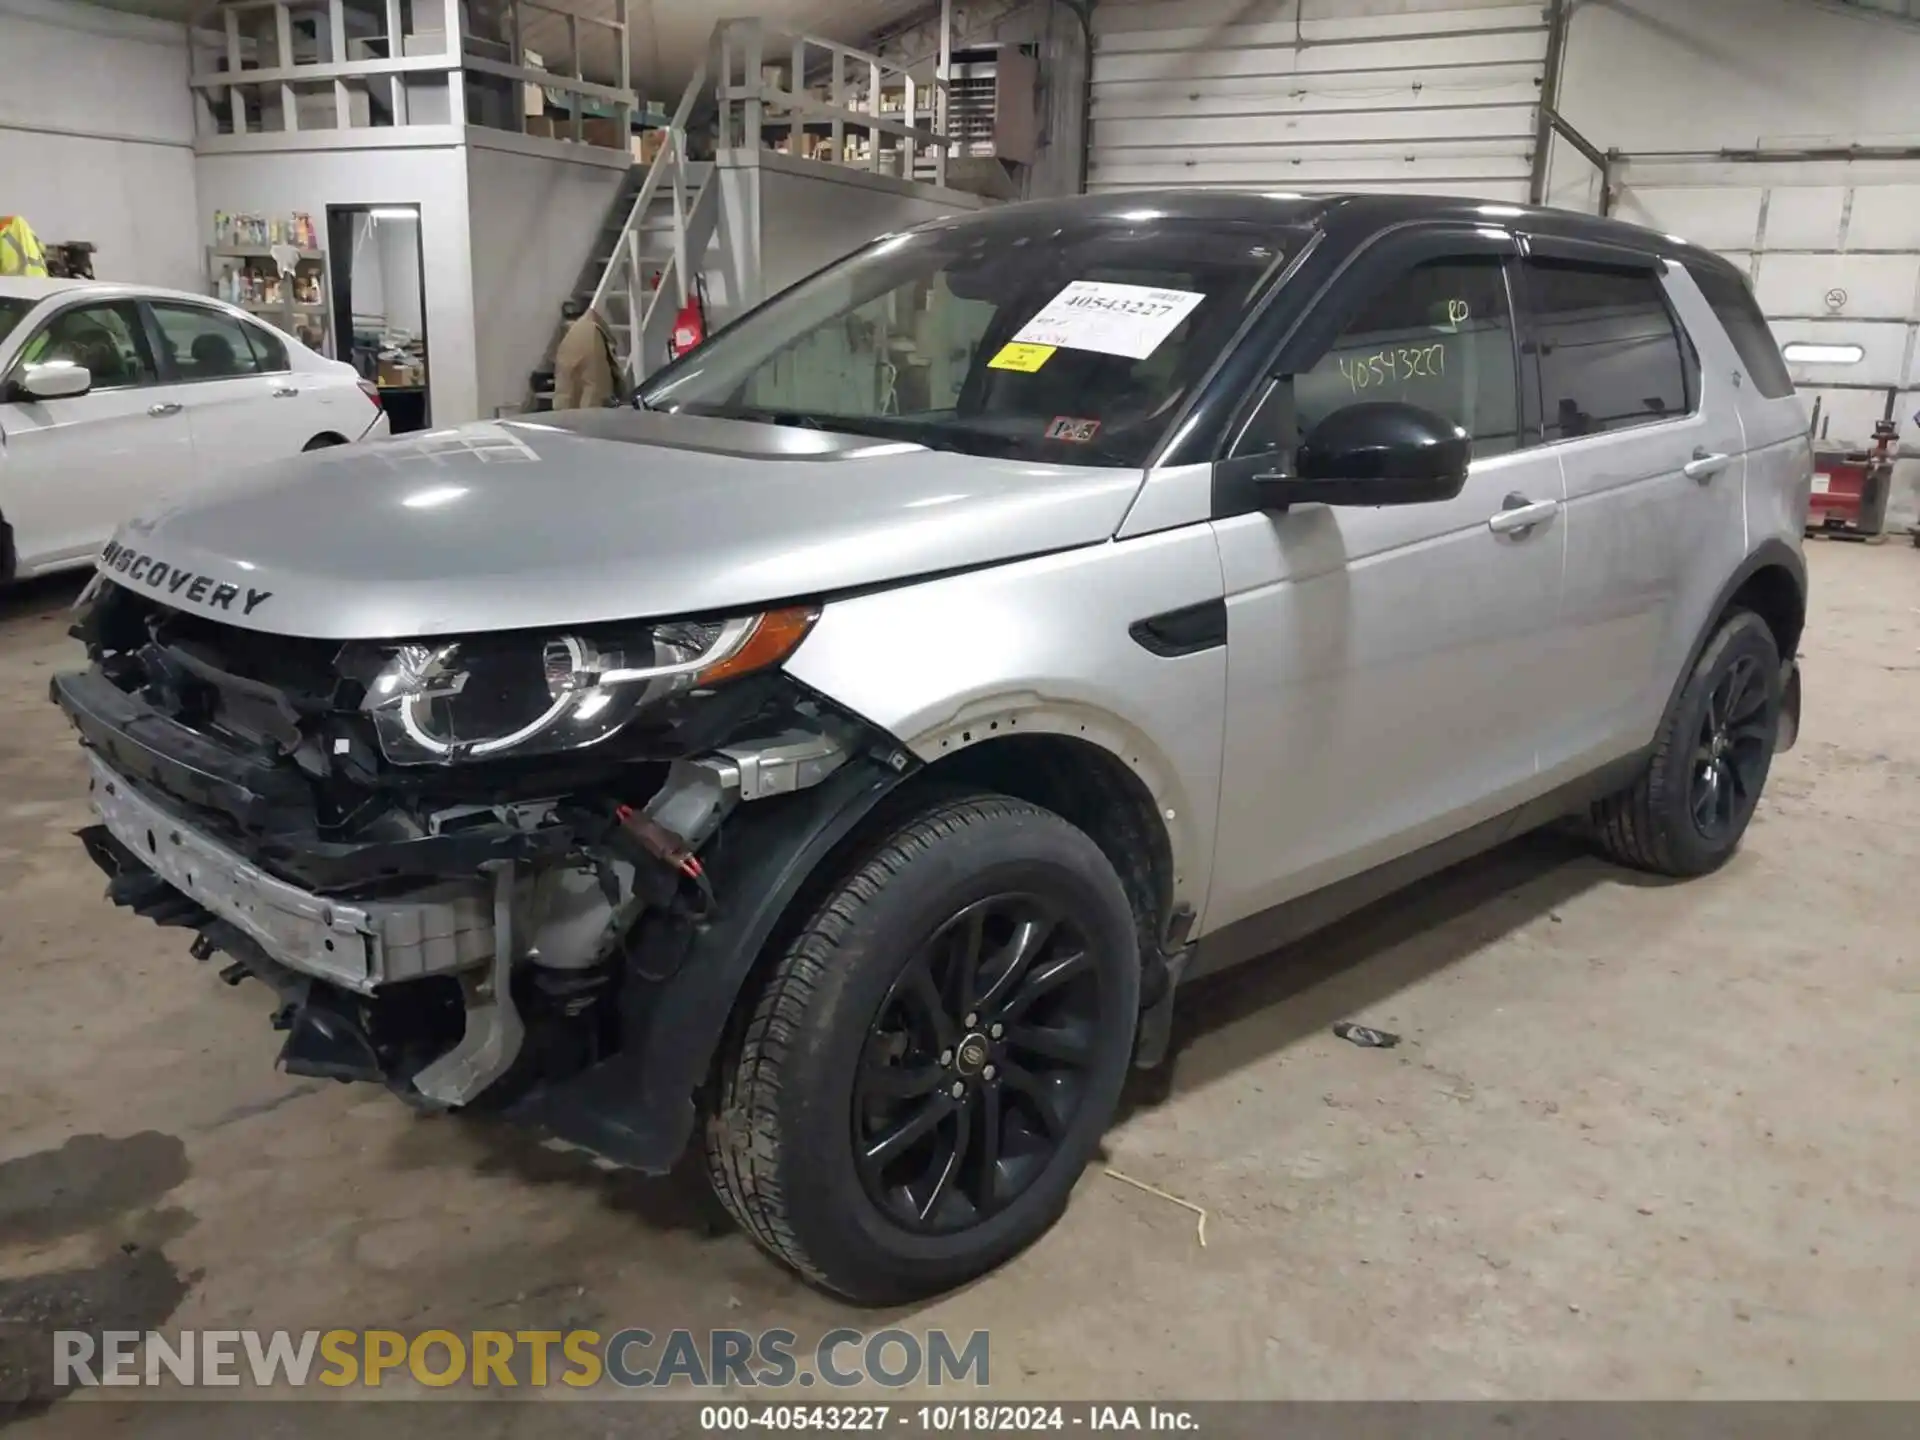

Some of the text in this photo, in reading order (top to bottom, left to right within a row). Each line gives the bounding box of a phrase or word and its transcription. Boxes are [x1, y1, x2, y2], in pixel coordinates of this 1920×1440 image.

[1064, 295, 1173, 317] 40543227
[1339, 344, 1445, 395] 40543227
[101, 541, 273, 615] DISCOVERY
